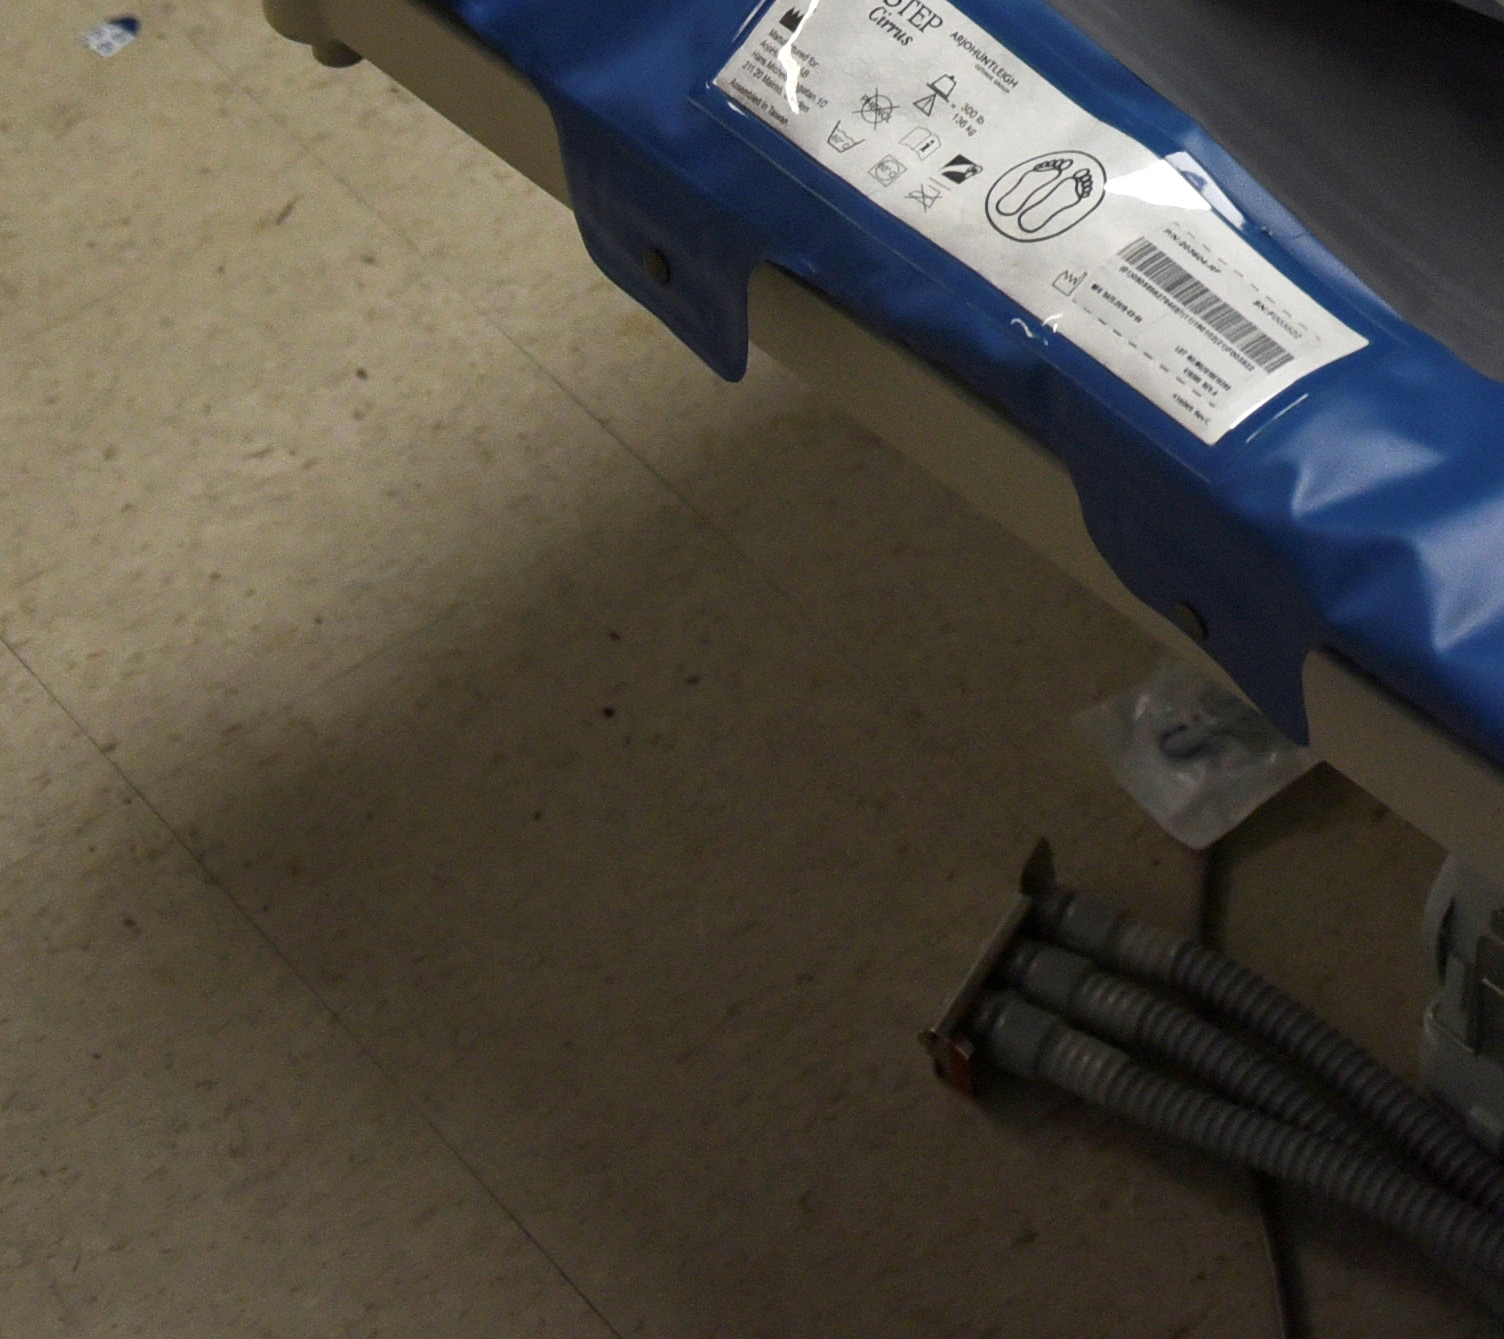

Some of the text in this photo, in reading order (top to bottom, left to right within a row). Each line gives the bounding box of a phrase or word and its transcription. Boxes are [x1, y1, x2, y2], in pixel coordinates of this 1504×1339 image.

[868, 6, 914, 46] Cirrus
[949, 31, 1019, 89] ARJOHUNTLEIGH
[952, 113, 977, 137] 136 kg
[960, 103, 979, 119] 300
